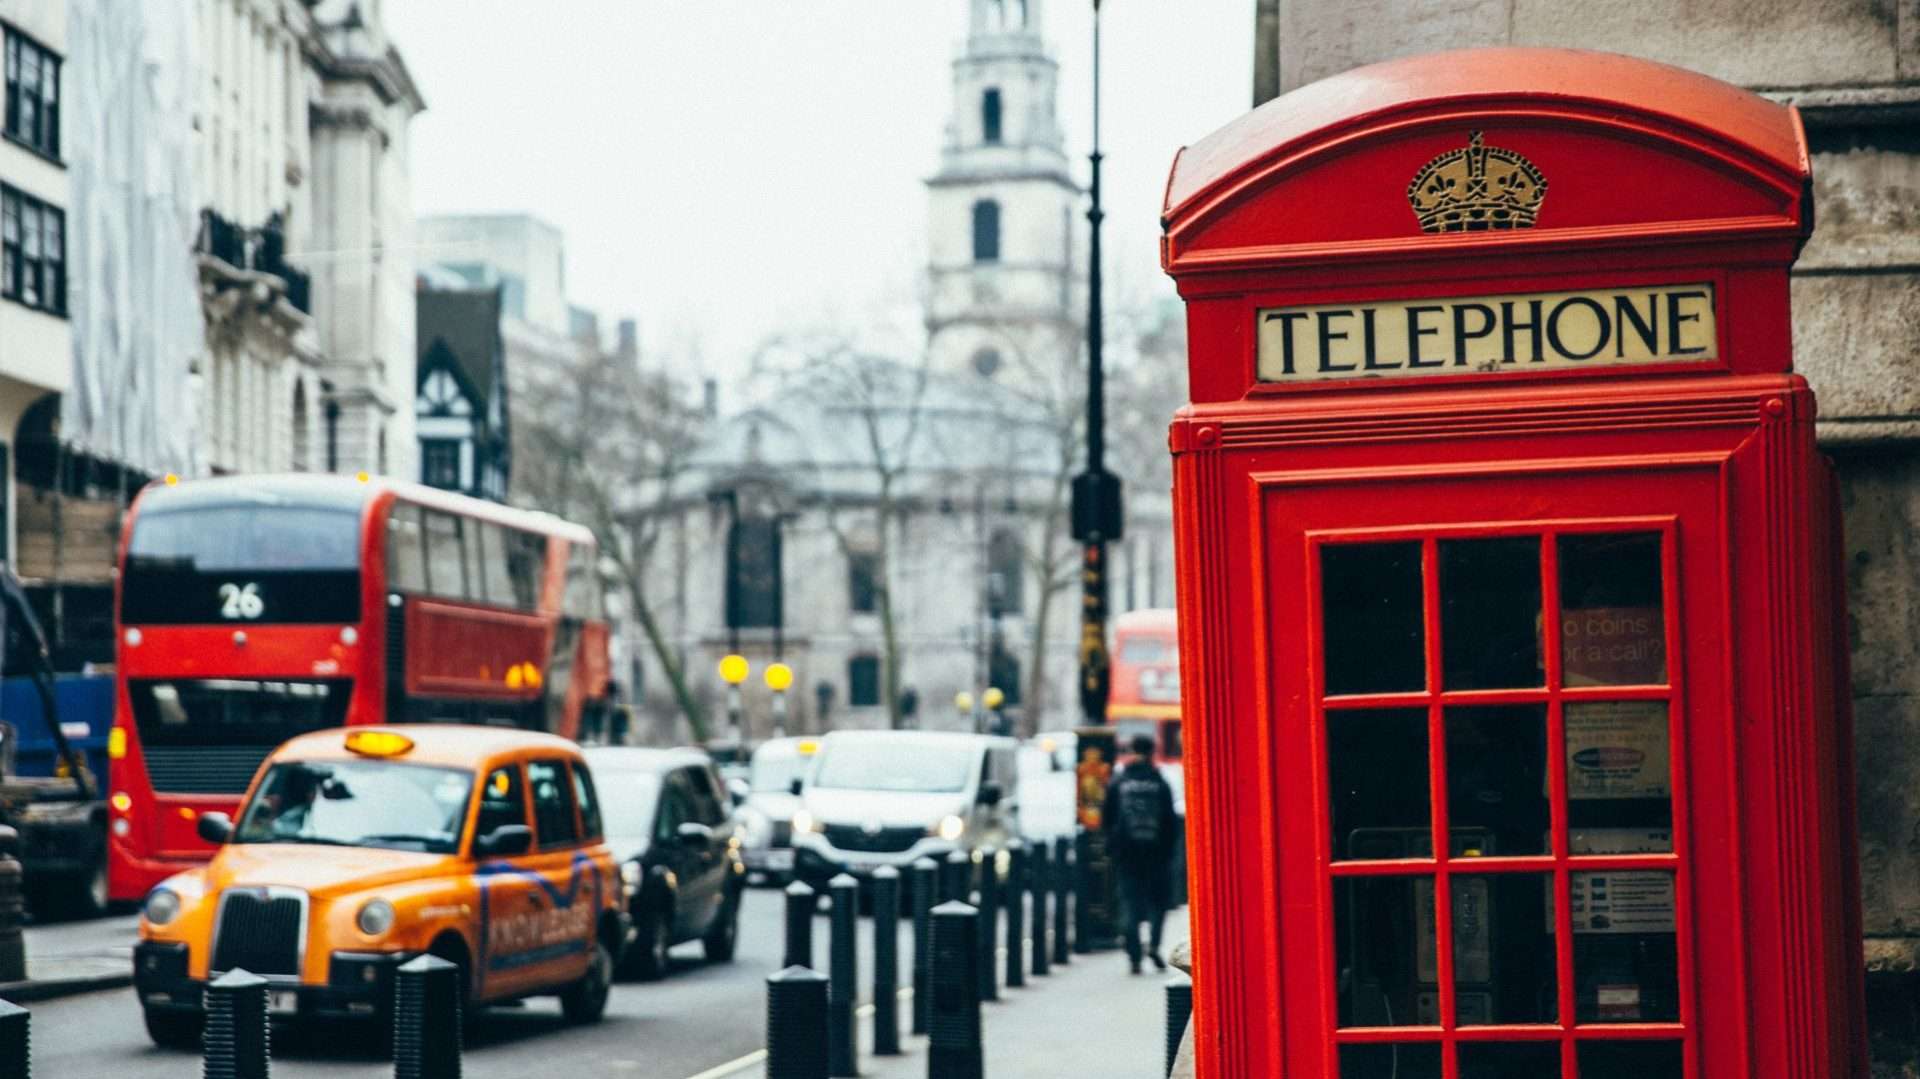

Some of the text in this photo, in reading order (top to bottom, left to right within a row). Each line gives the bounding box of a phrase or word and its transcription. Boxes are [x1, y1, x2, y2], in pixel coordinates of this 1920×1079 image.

[1265, 290, 1708, 375] TELEPHONE
[219, 582, 264, 619] 26
[1586, 616, 1649, 636] coins
[1585, 645, 1601, 662] a
[1608, 638, 1661, 662] call?
